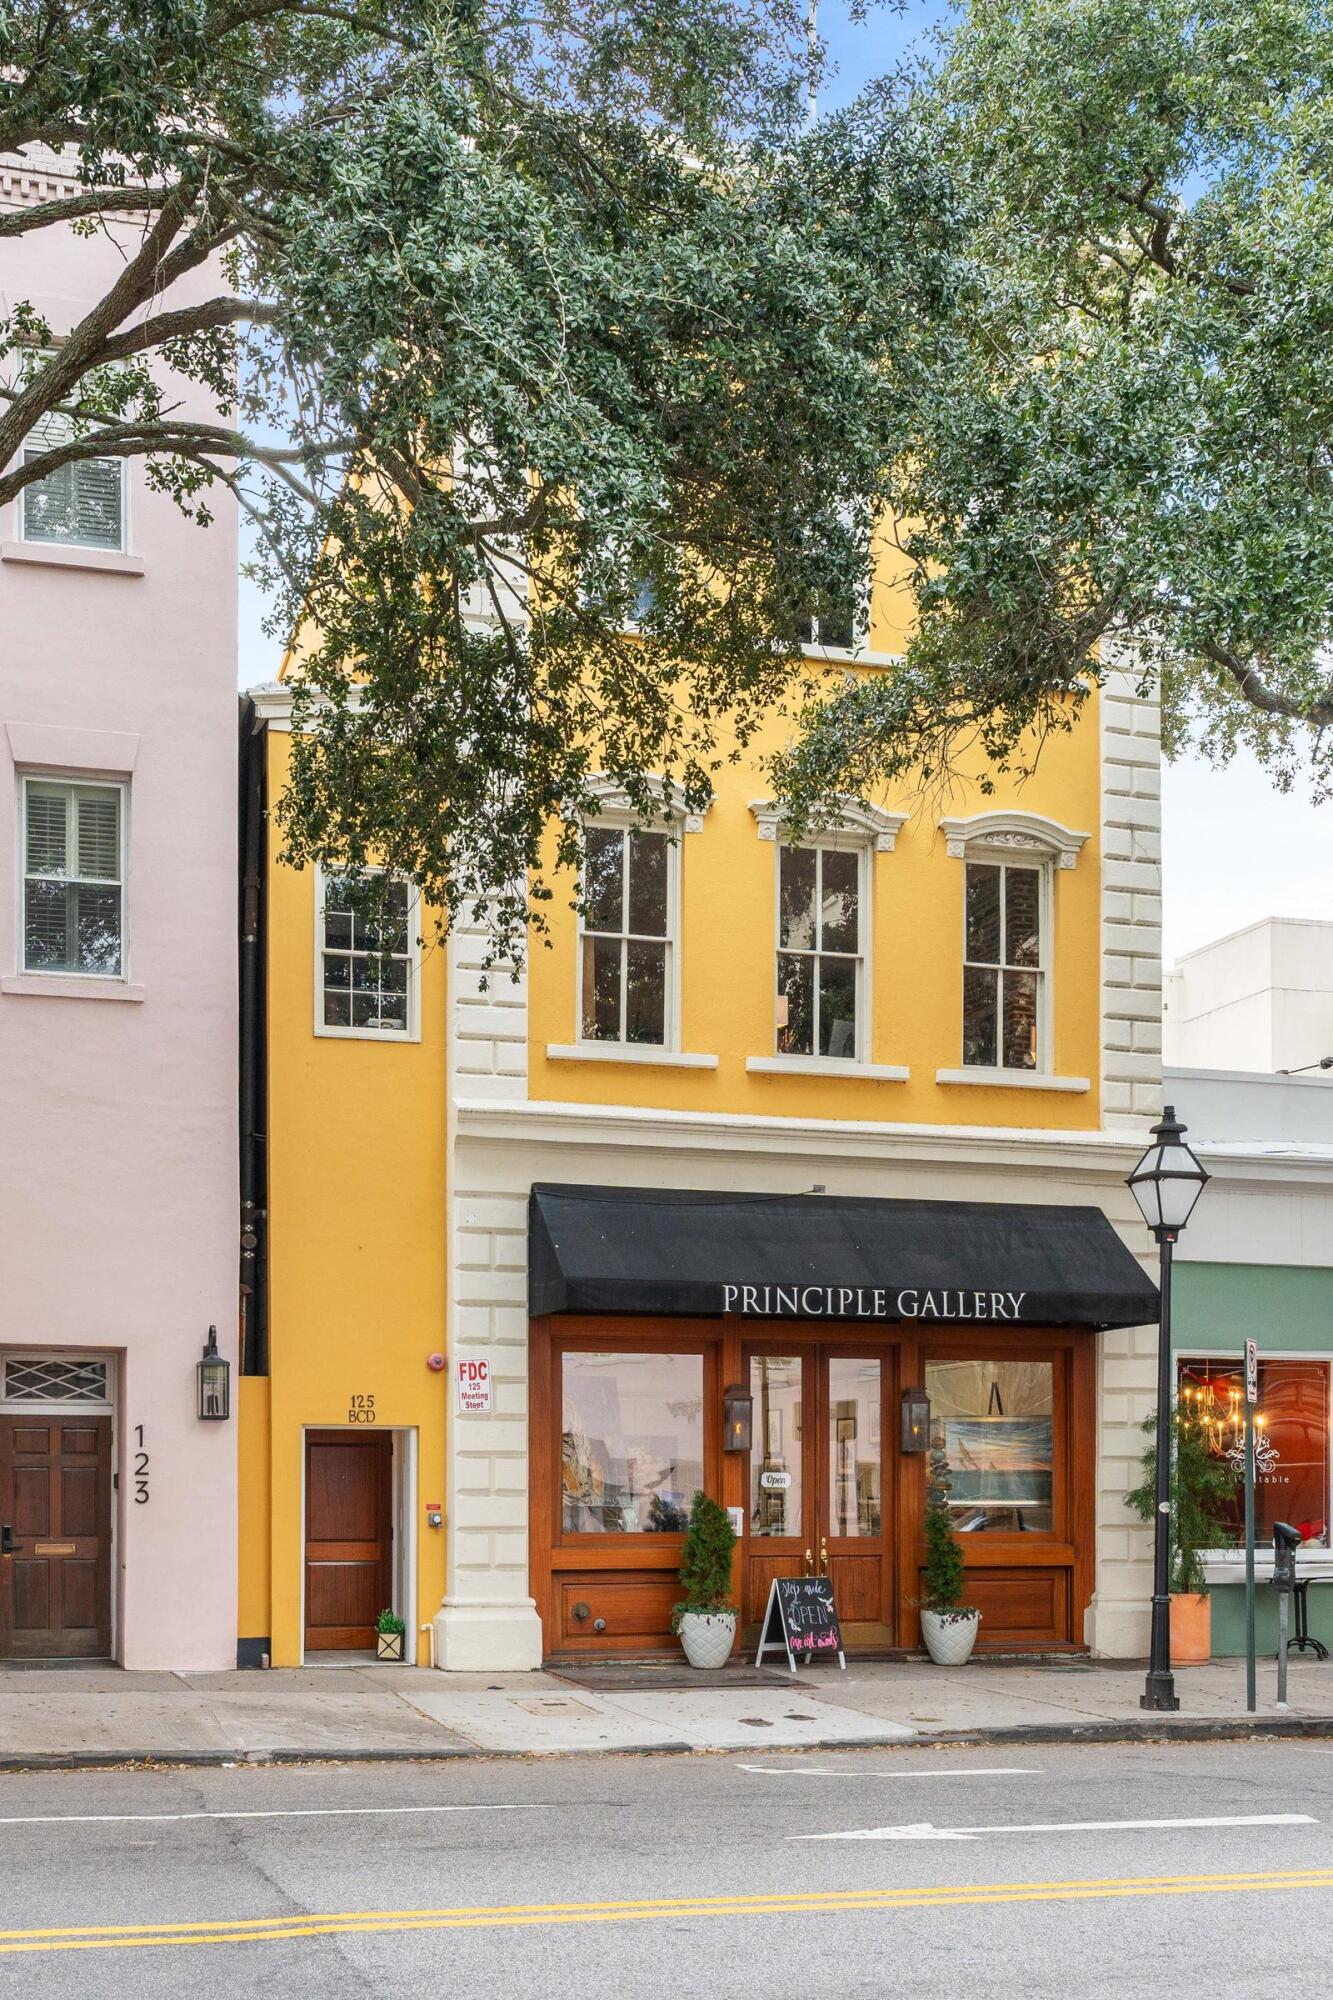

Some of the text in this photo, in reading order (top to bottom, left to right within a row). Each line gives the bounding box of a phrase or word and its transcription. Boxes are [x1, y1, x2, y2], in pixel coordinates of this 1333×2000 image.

[722, 1284, 1026, 1319] PRINCIPLE GALLERY
[459, 1361, 488, 1381] FDC
[468, 1383, 481, 1391] 125
[351, 1394, 375, 1408] 125
[461, 1392, 489, 1401] Meeting
[348, 1409, 376, 1423] BCD
[134, 1424, 150, 1504] 123
[766, 1475, 786, 1486] Open
[792, 1604, 828, 1626] OPEN
